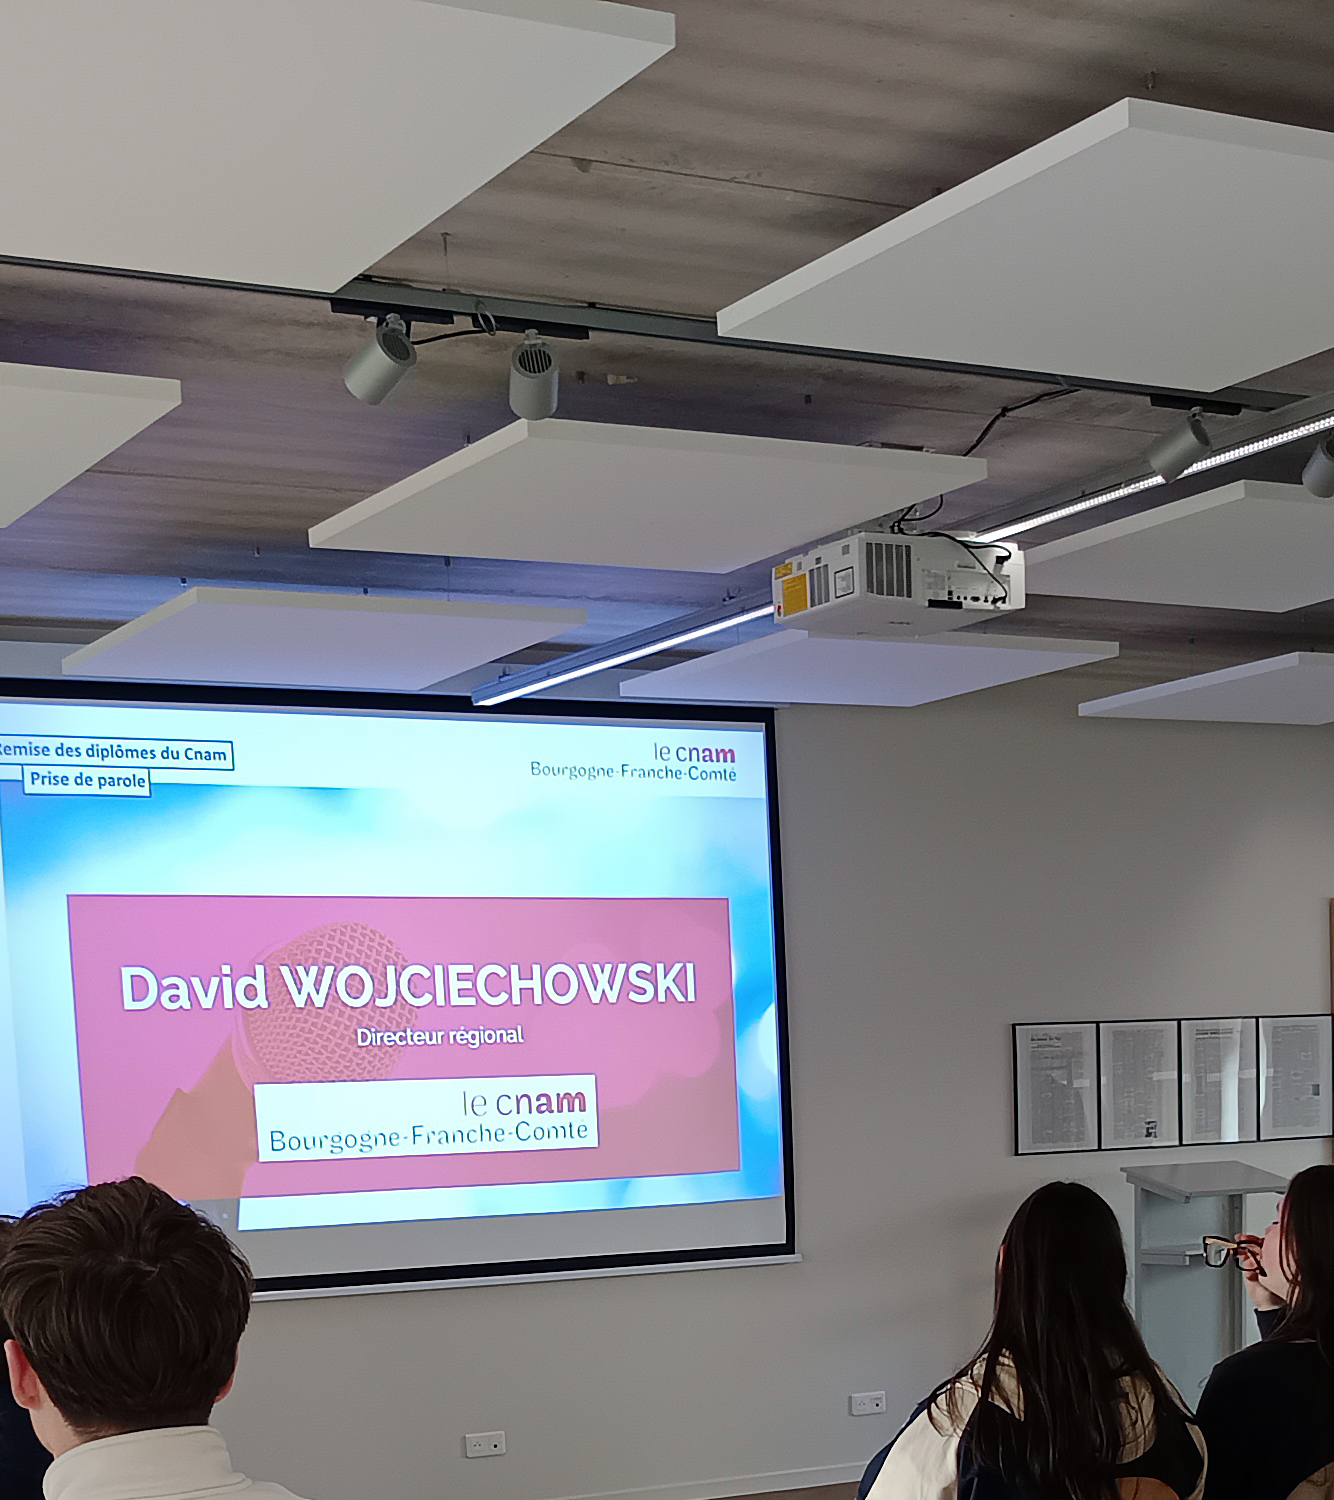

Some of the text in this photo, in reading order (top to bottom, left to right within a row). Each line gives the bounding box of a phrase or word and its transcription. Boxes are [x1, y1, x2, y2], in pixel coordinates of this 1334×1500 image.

[54, 742, 82, 758] des
[85, 743, 157, 762] diplômes
[160, 744, 180, 760] du
[184, 747, 227, 762] Cnam
[653, 742, 736, 763] le cnam
[30, 771, 147, 790] Prise de parole
[530, 760, 737, 781] Bourgogne-Franche-Comté
[120, 961, 698, 1011] David WOJCIECHOWSKI
[356, 1024, 524, 1049] Directeur régional
[462, 1090, 587, 1117] le cnam
